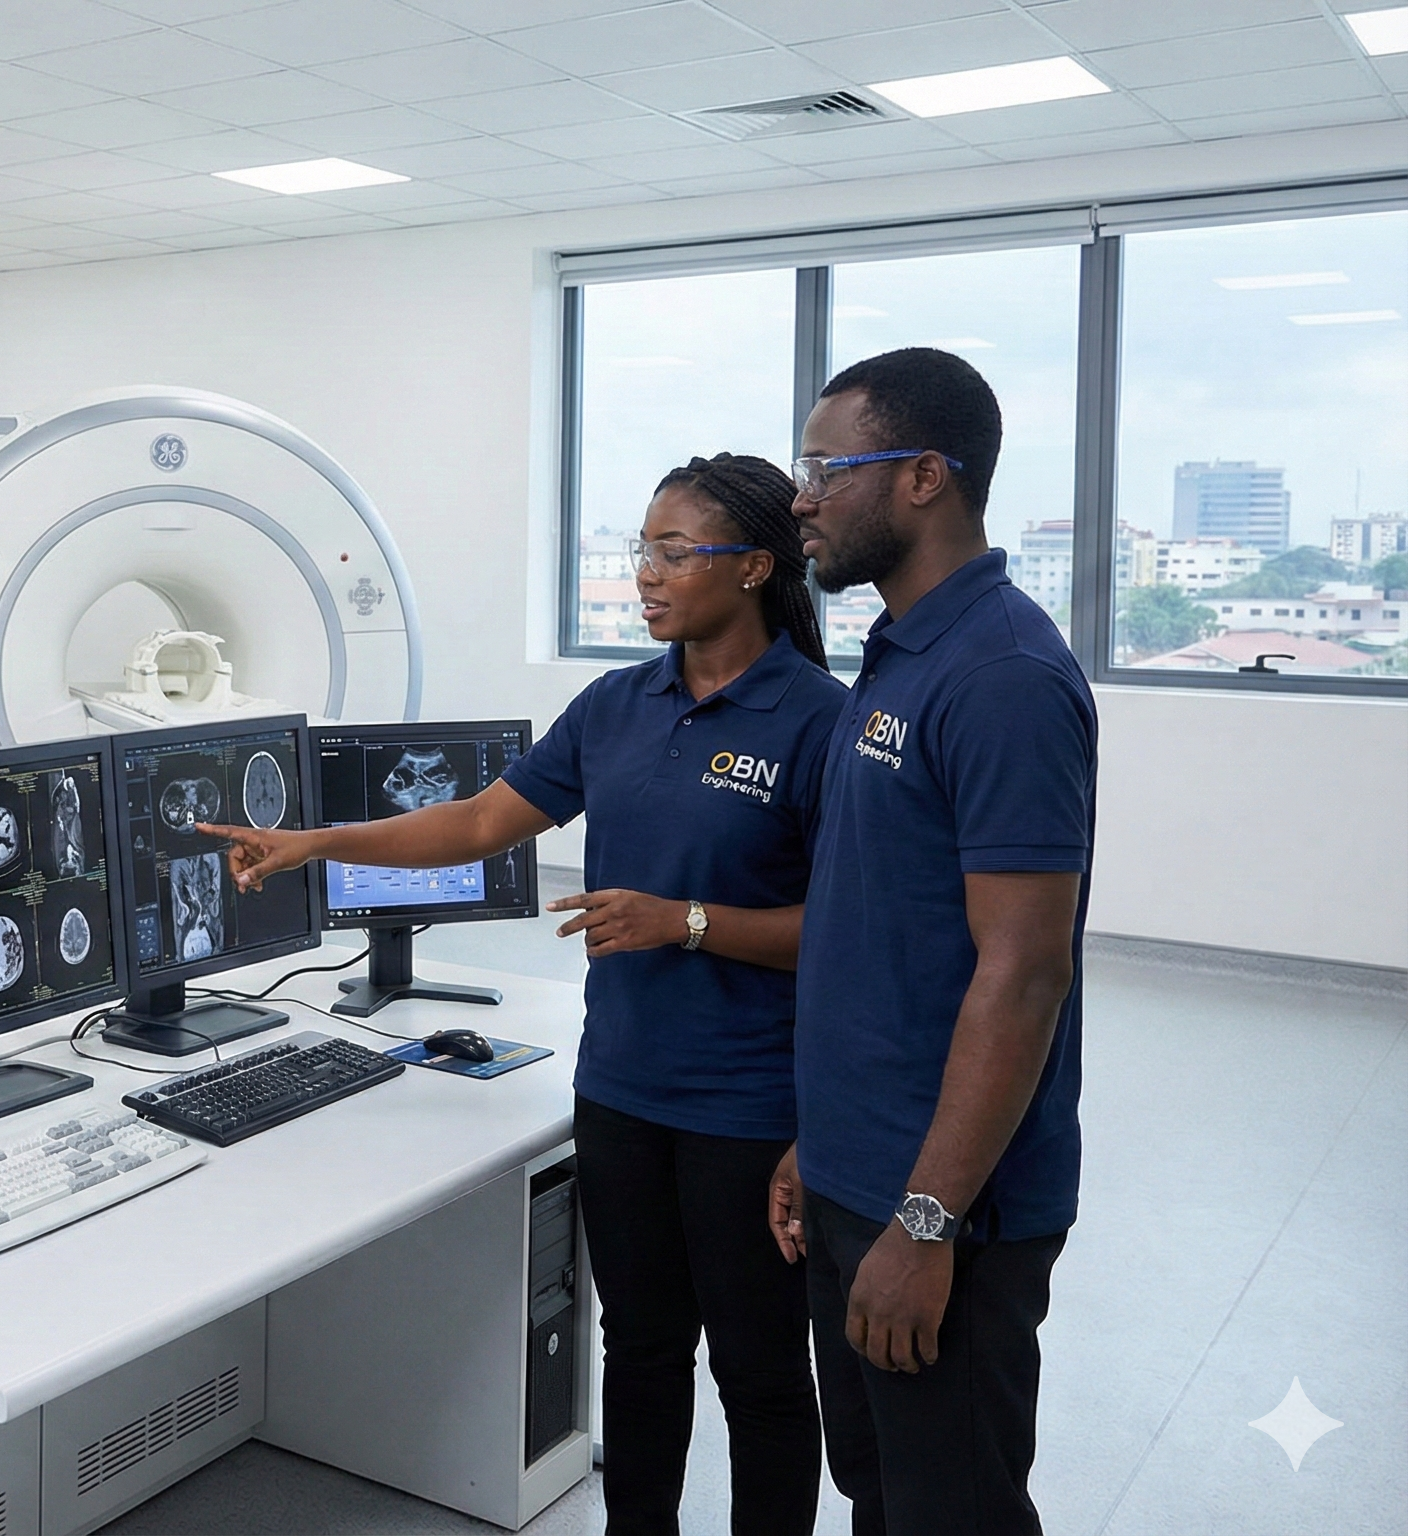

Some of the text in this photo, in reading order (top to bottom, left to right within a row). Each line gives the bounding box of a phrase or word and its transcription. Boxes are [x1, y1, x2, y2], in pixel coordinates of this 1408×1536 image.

[865, 710, 908, 751] OBN
[701, 772, 771, 803] Engineering
[711, 751, 780, 788] OBN
